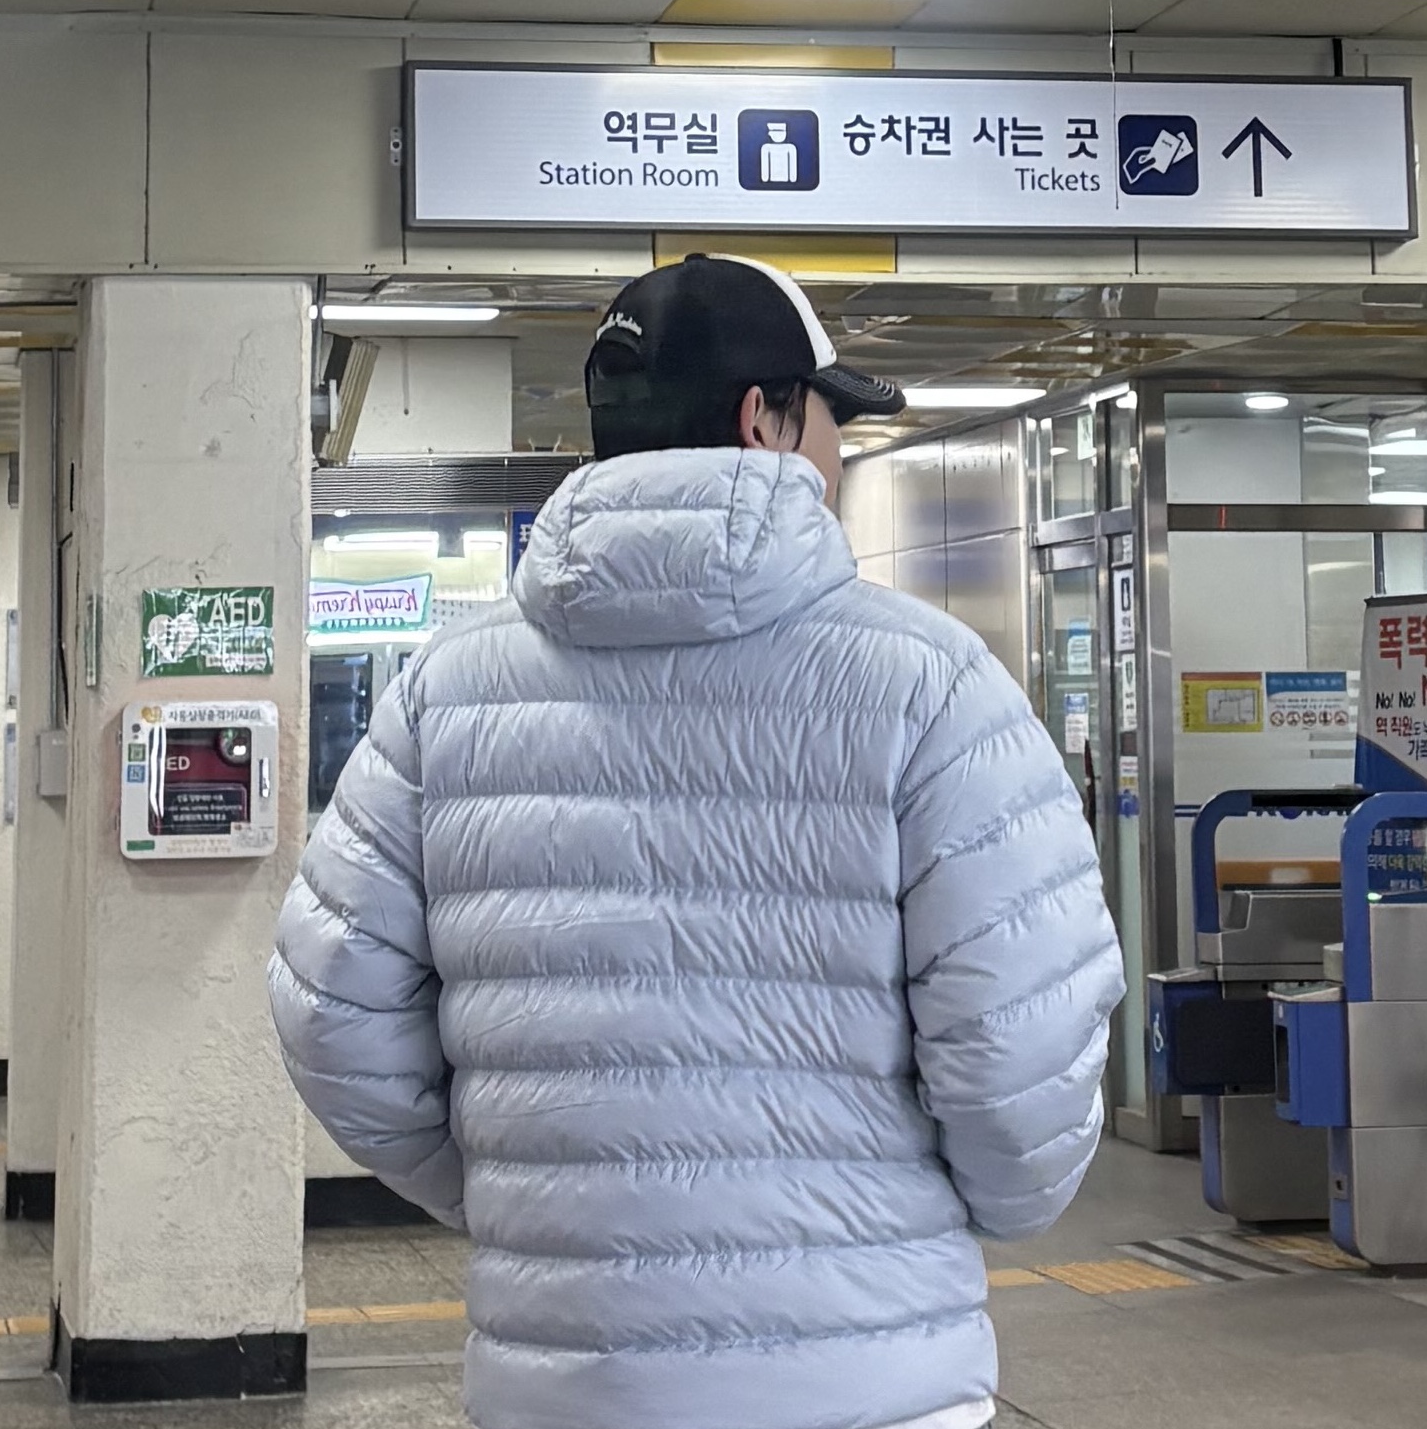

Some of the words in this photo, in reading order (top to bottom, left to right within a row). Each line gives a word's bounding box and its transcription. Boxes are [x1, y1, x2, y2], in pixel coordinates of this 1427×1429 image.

[604, 111, 718, 154] 역무실
[843, 115, 951, 157] 승차권
[973, 117, 1044, 157] 사는
[1066, 119, 1099, 159] 곳
[539, 161, 633, 187] Station
[643, 162, 719, 187] Room
[1016, 167, 1101, 191] Tickets
[209, 597, 265, 626] AED
[1376, 692, 1394, 709] No!
[1399, 691, 1416, 708] No!
[1376, 717, 1388, 737] 역
[1391, 716, 1421, 737] 직원도
[166, 756, 190, 771] ED
